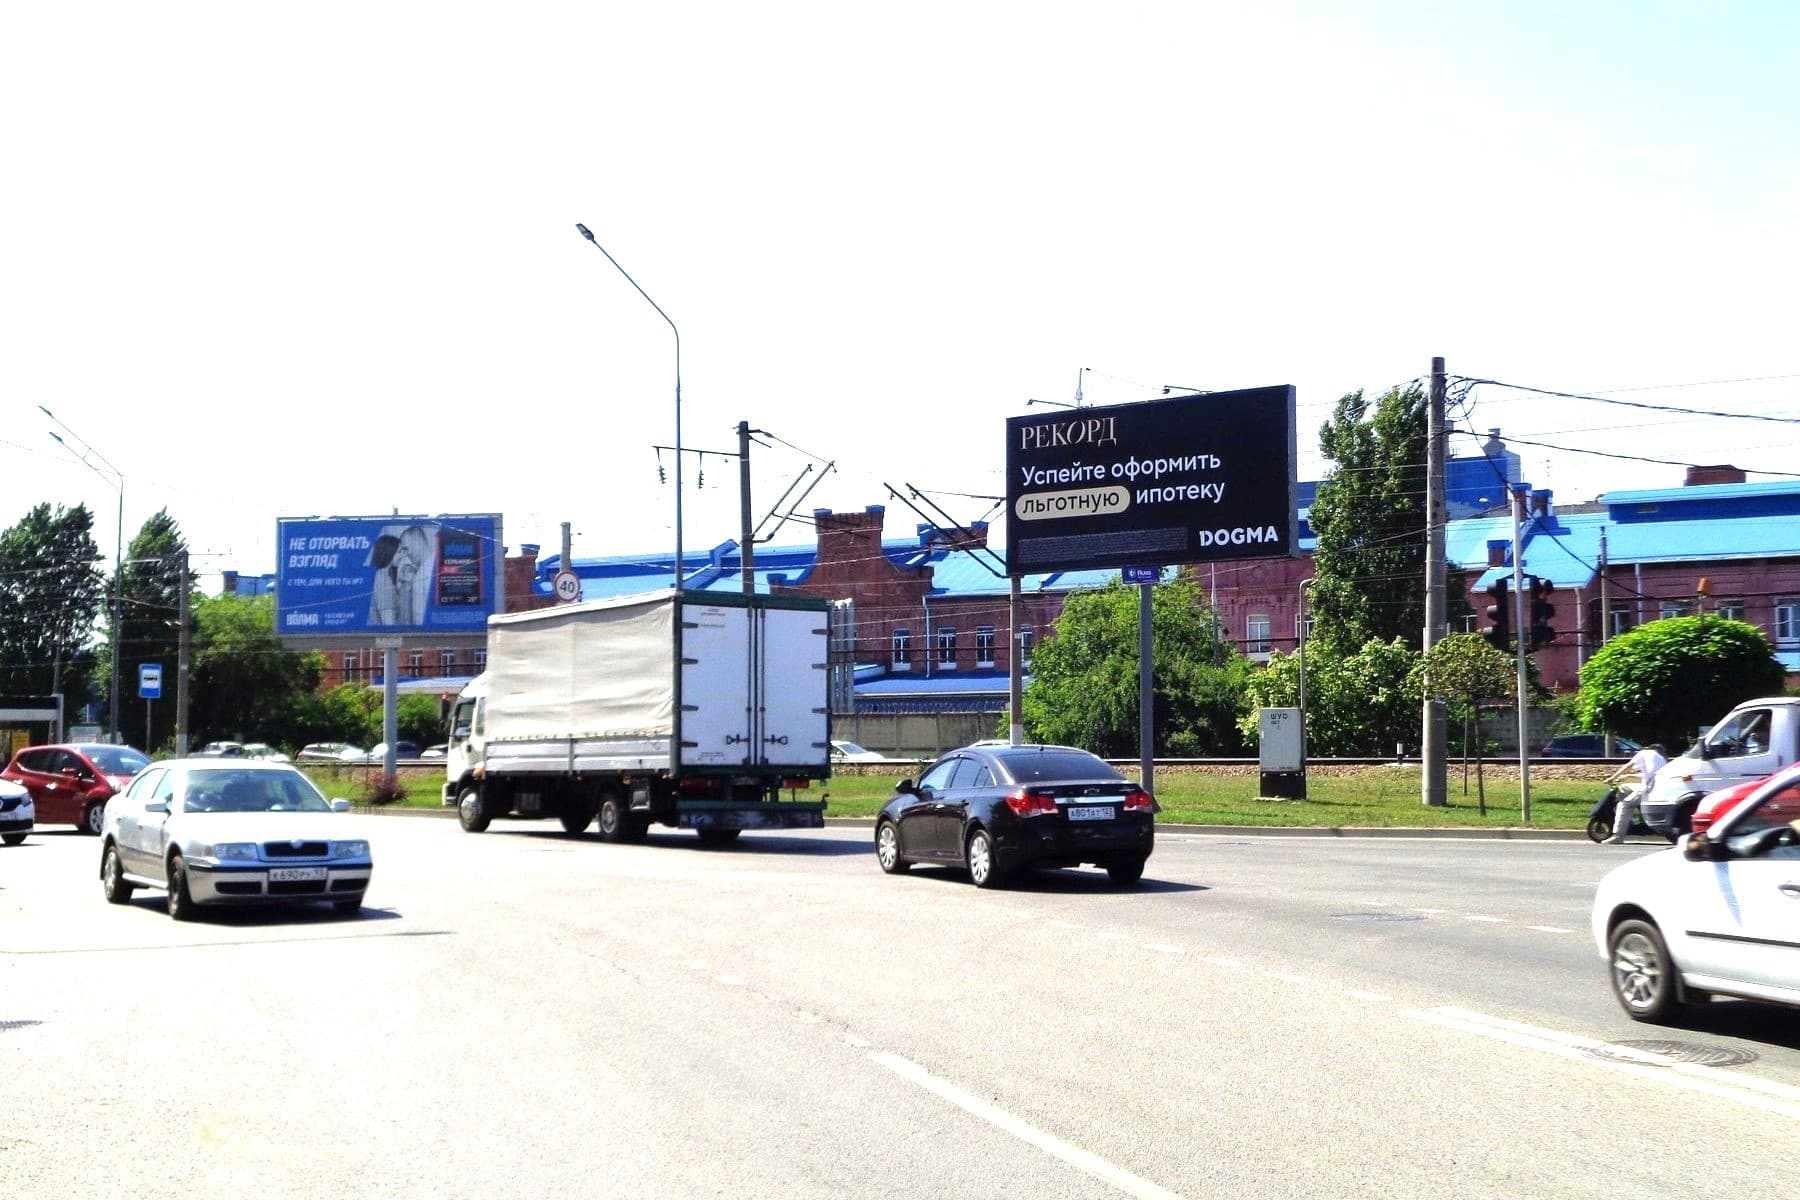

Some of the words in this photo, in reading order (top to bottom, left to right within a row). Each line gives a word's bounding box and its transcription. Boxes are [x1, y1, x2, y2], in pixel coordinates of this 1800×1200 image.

[1020, 417, 1117, 449] РЕКОРД
[1021, 462, 1106, 486] Успейте
[1111, 454, 1221, 481] оформить
[1022, 490, 1120, 514] льготную
[1136, 482, 1225, 505] ипотеку
[289, 537, 306, 550] НЕ
[308, 536, 370, 550] ОТОРВАТЬ
[1199, 525, 1279, 547] DOGMA
[288, 554, 338, 569] ВЗГЛЯД
[560, 580, 575, 593] 40
